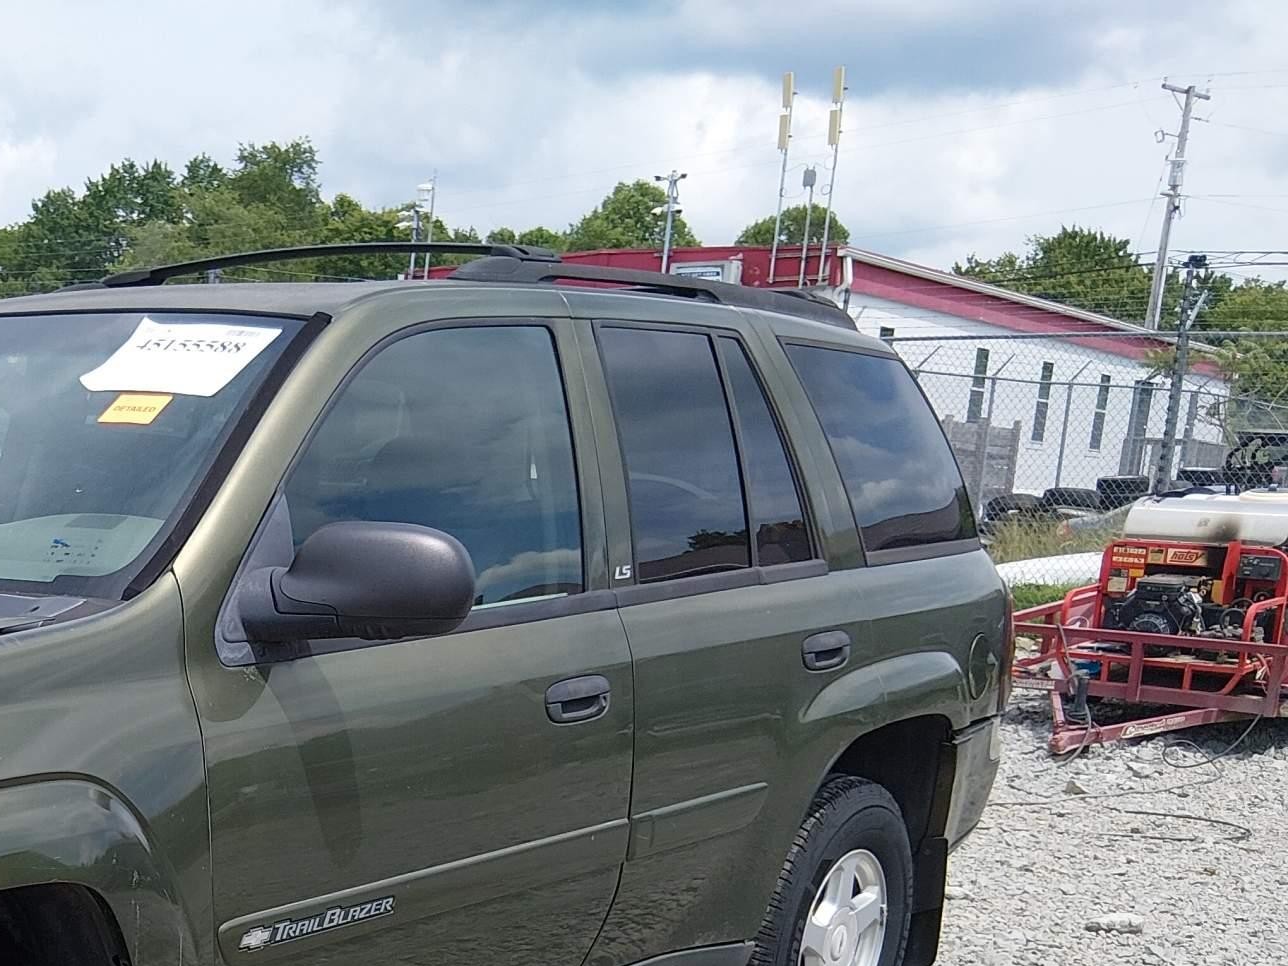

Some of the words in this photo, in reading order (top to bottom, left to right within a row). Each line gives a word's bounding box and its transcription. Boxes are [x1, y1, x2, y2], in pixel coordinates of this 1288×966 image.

[136, 338, 247, 353] 45155588
[113, 405, 157, 413] DETAILED
[1170, 550, 1206, 563] hotsy
[614, 564, 631, 580] LS
